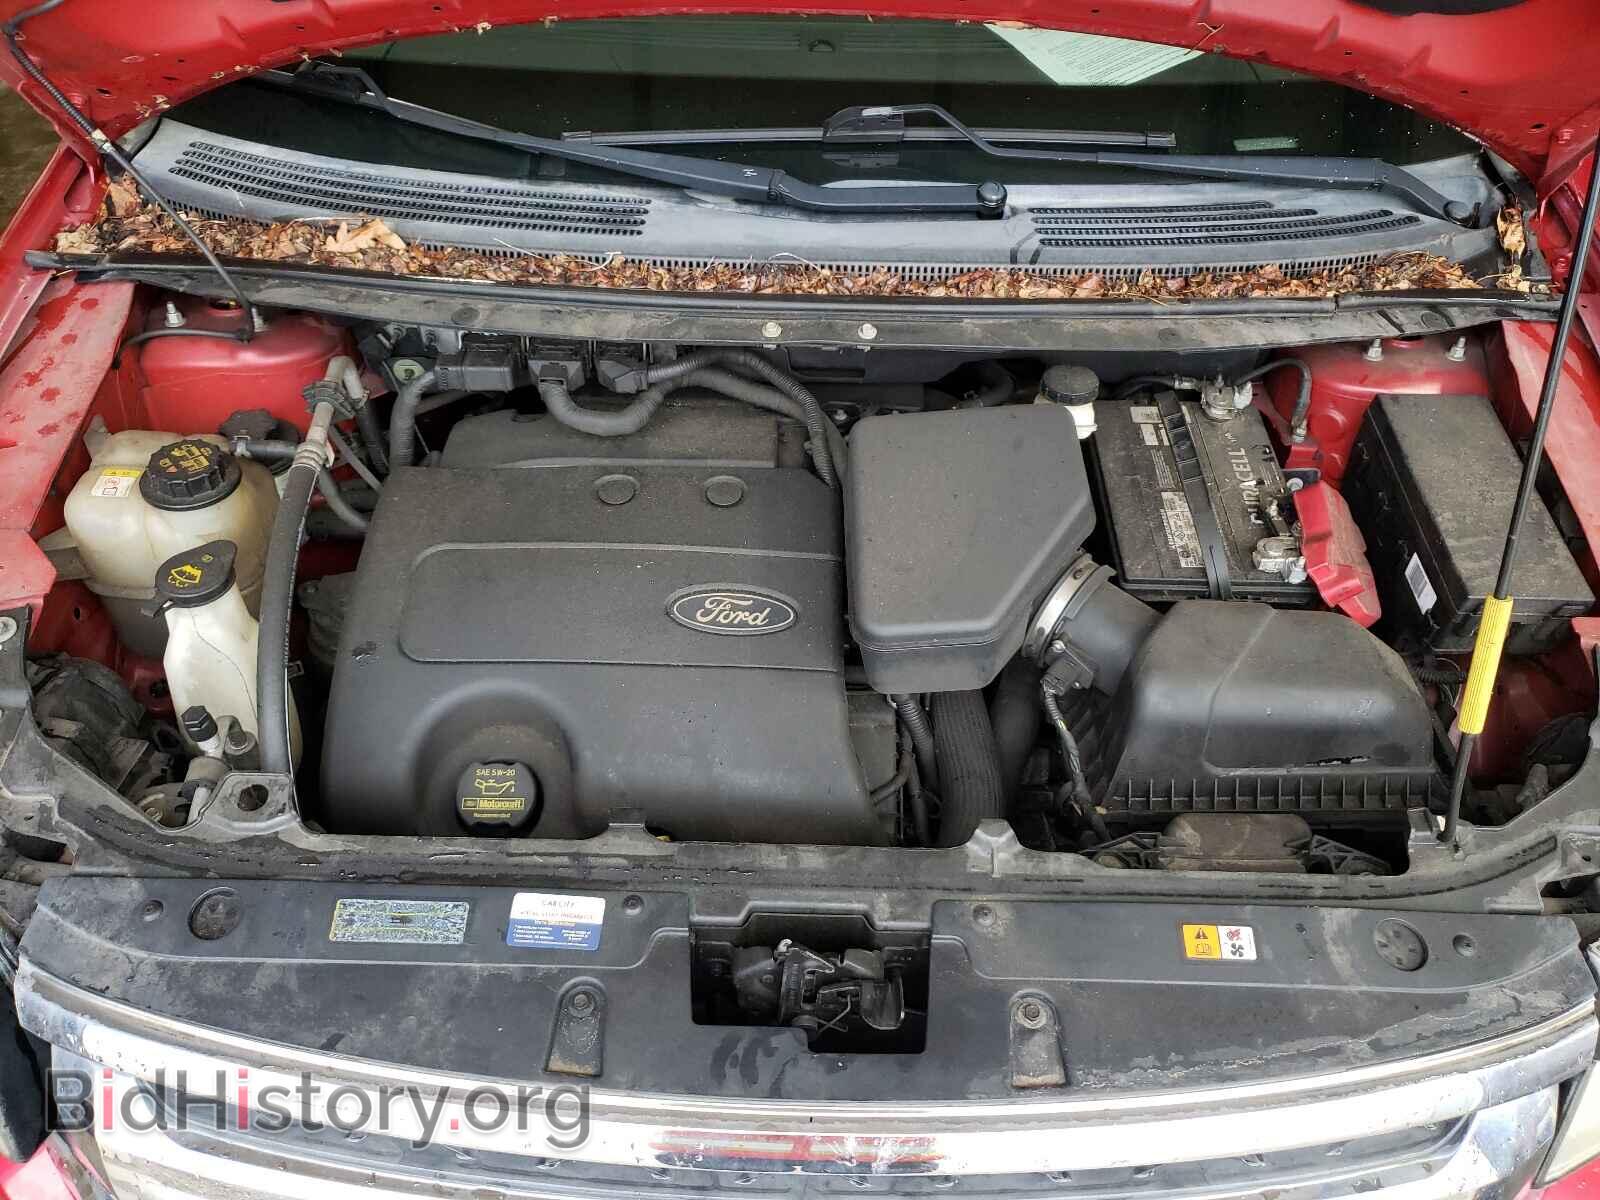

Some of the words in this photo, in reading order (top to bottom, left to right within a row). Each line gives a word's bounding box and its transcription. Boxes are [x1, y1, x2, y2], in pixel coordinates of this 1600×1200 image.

[695, 596, 771, 625] Ford
[475, 768, 491, 776] SAE
[491, 768, 516, 776] 5W-20
[479, 799, 521, 808] Motorcraft
